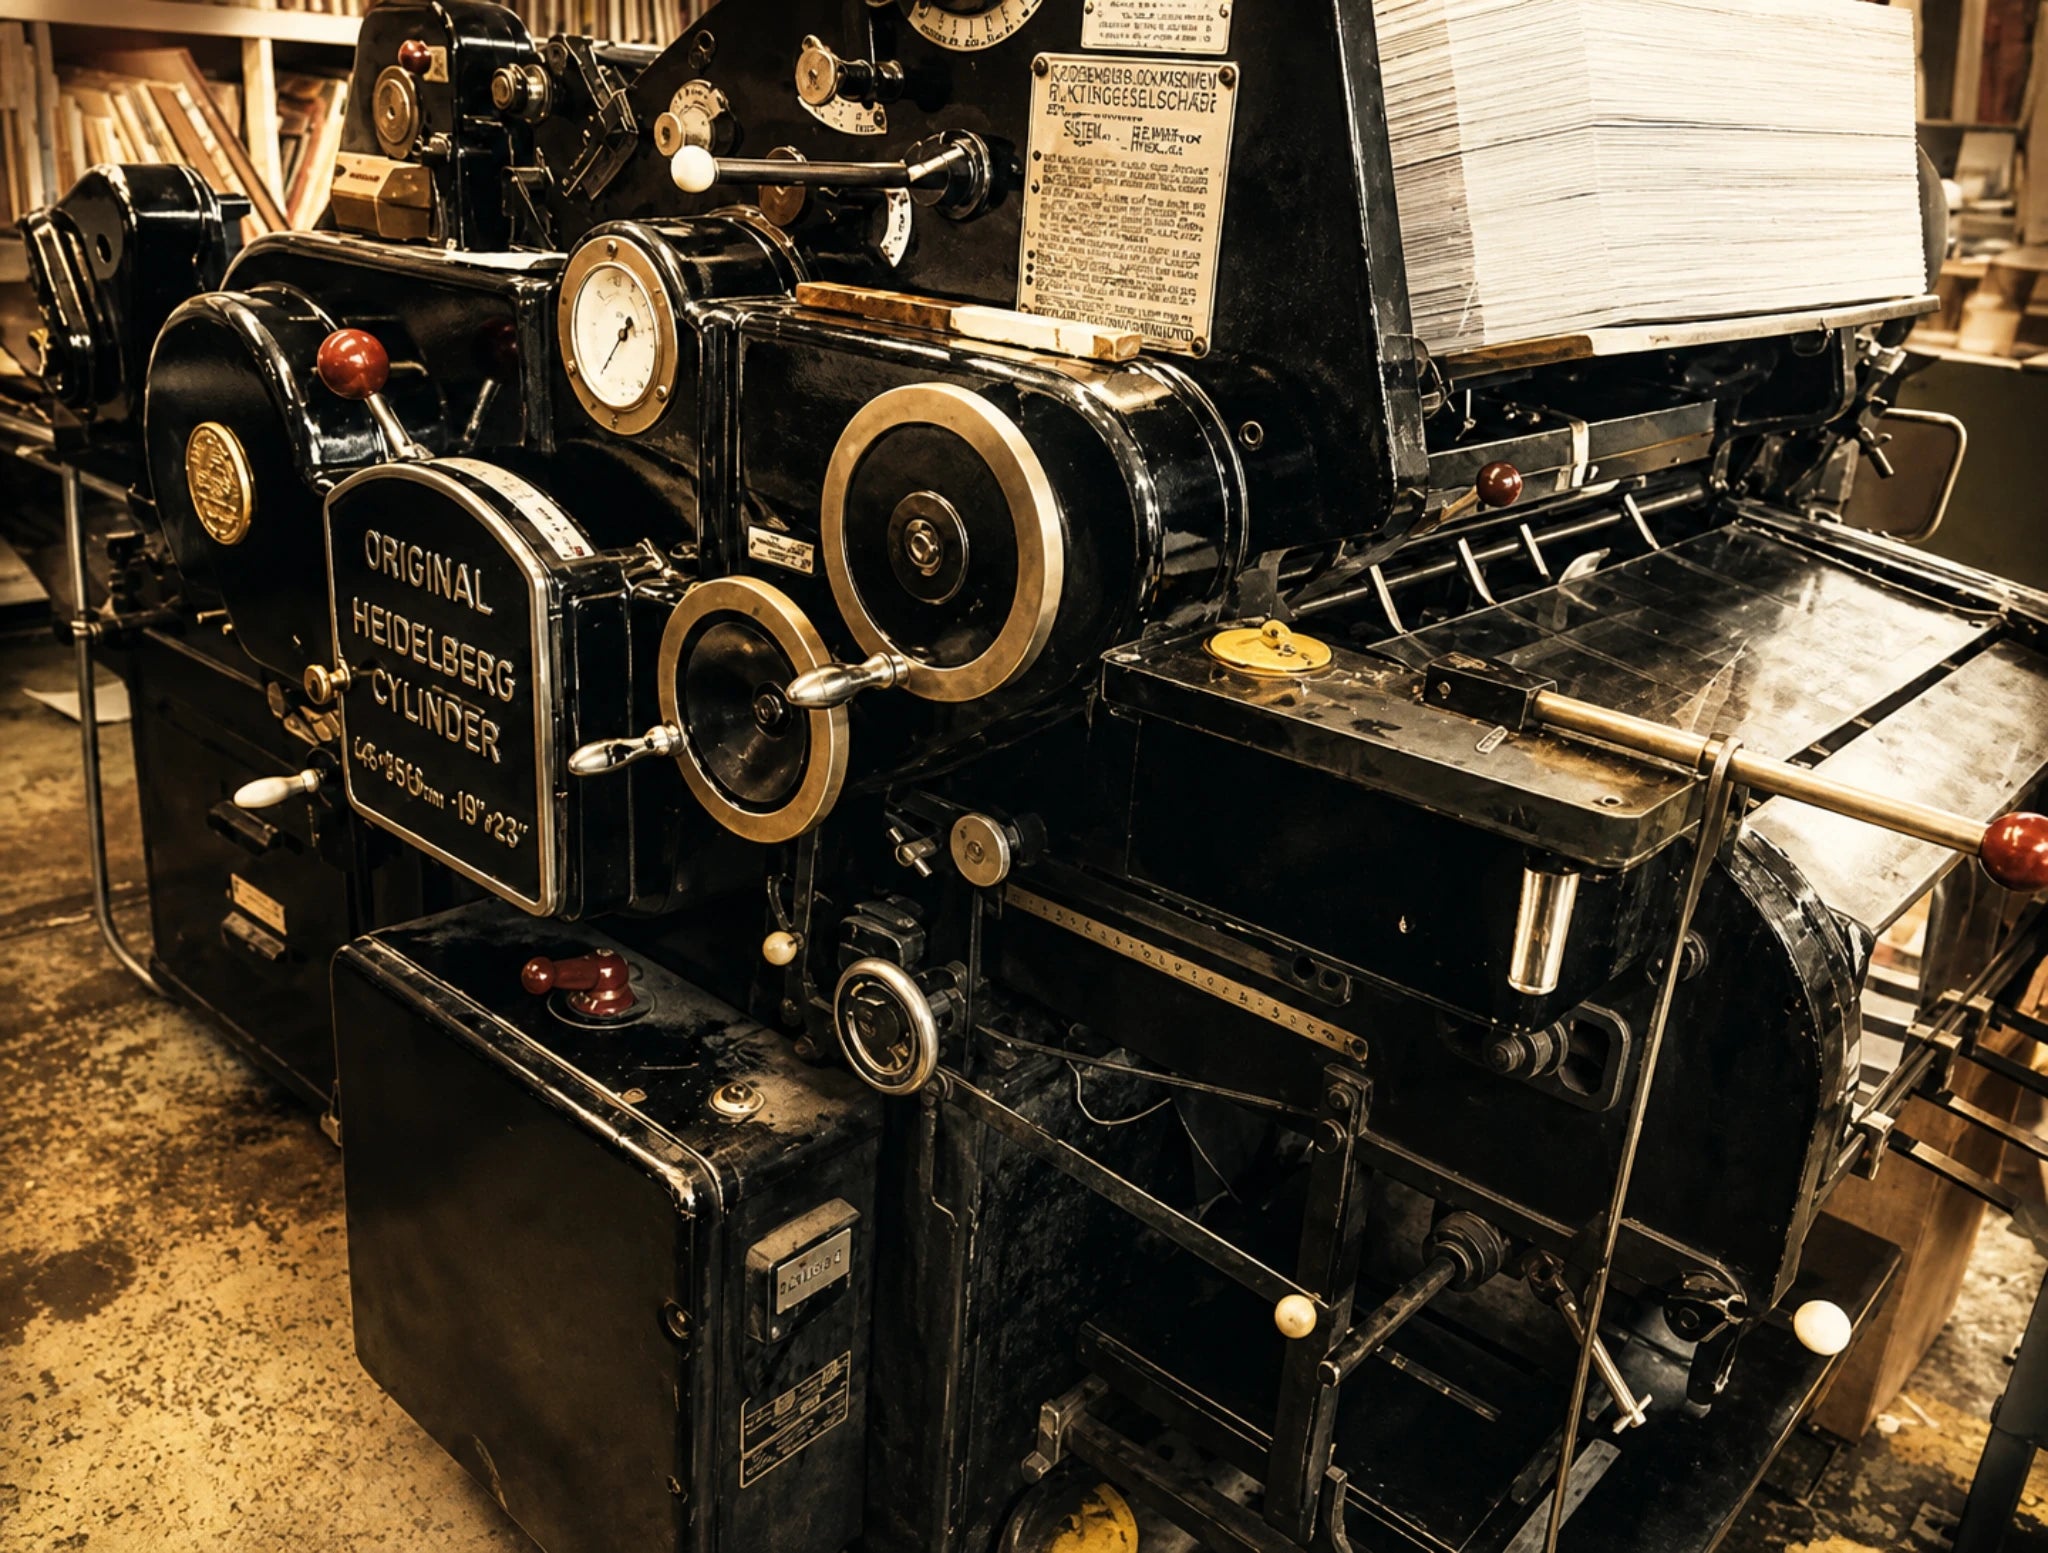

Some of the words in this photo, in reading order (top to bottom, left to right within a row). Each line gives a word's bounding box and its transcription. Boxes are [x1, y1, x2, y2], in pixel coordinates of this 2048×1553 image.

[364, 529, 493, 616] ORIGINAL
[353, 597, 516, 702] HEIDELBERG
[372, 668, 501, 764] CYLINDER
